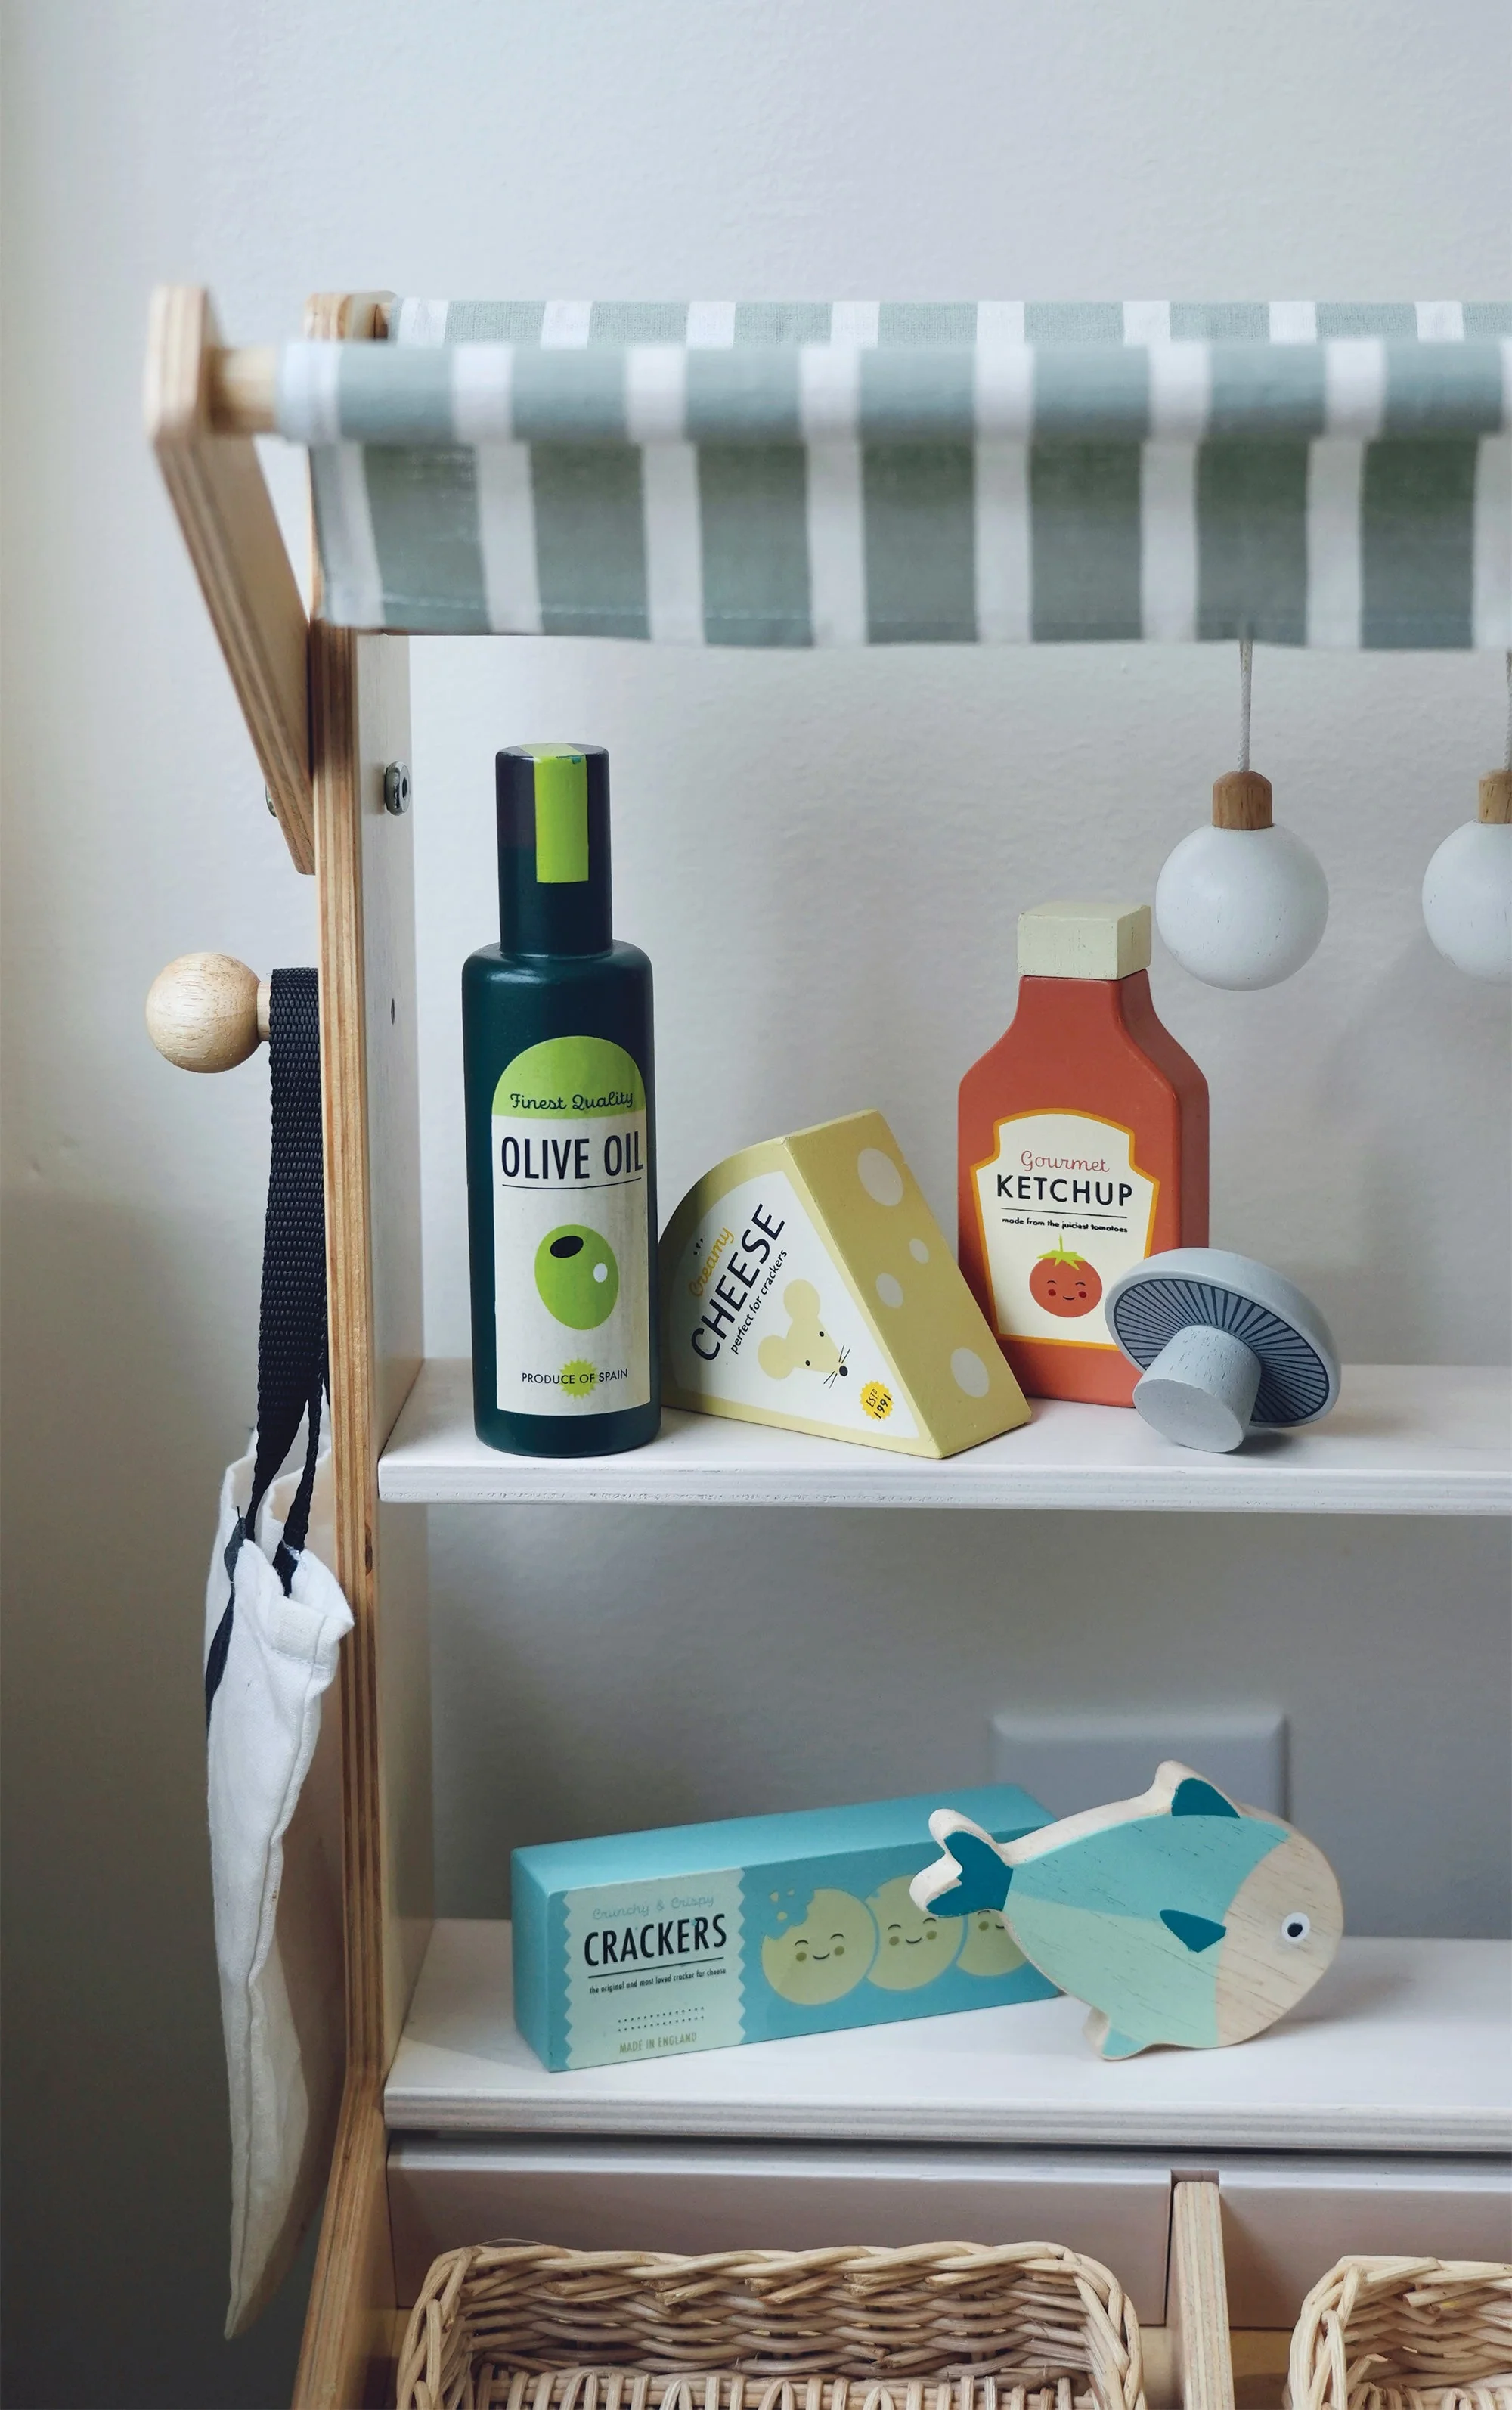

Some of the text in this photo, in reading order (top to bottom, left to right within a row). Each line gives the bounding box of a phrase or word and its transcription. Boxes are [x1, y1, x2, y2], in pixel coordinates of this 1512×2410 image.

[510, 1091, 634, 1110] Finest Quality
[501, 1131, 644, 1180] OLIVE OIL
[1021, 1150, 1110, 1172] Gourmet
[997, 1174, 1132, 1206] KETCHUP
[1027, 1217, 1045, 1226] from
[1061, 1221, 1089, 1230] juiciest
[1091, 1223, 1128, 1233] tomatoes
[689, 1227, 735, 1297] Creamy
[691, 1203, 785, 1360] CHEESE
[730, 1249, 787, 1354] perfect for crackers
[522, 1368, 627, 1384] PRODUCE OF SPAIN
[874, 1393, 891, 1419] 1991
[593, 1895, 714, 1920] Crunchy & Crispy
[584, 1913, 727, 1966] CRACKERS
[589, 1986, 600, 1994] the
[601, 1980, 624, 1993] original
[626, 1980, 637, 1988] and
[640, 1978, 654, 1987] most
[655, 1974, 671, 1984] loved
[673, 1971, 694, 1981] cracker
[706, 1968, 727, 1976] cheese
[619, 2032, 697, 2053] MADE IN ENGLAND
